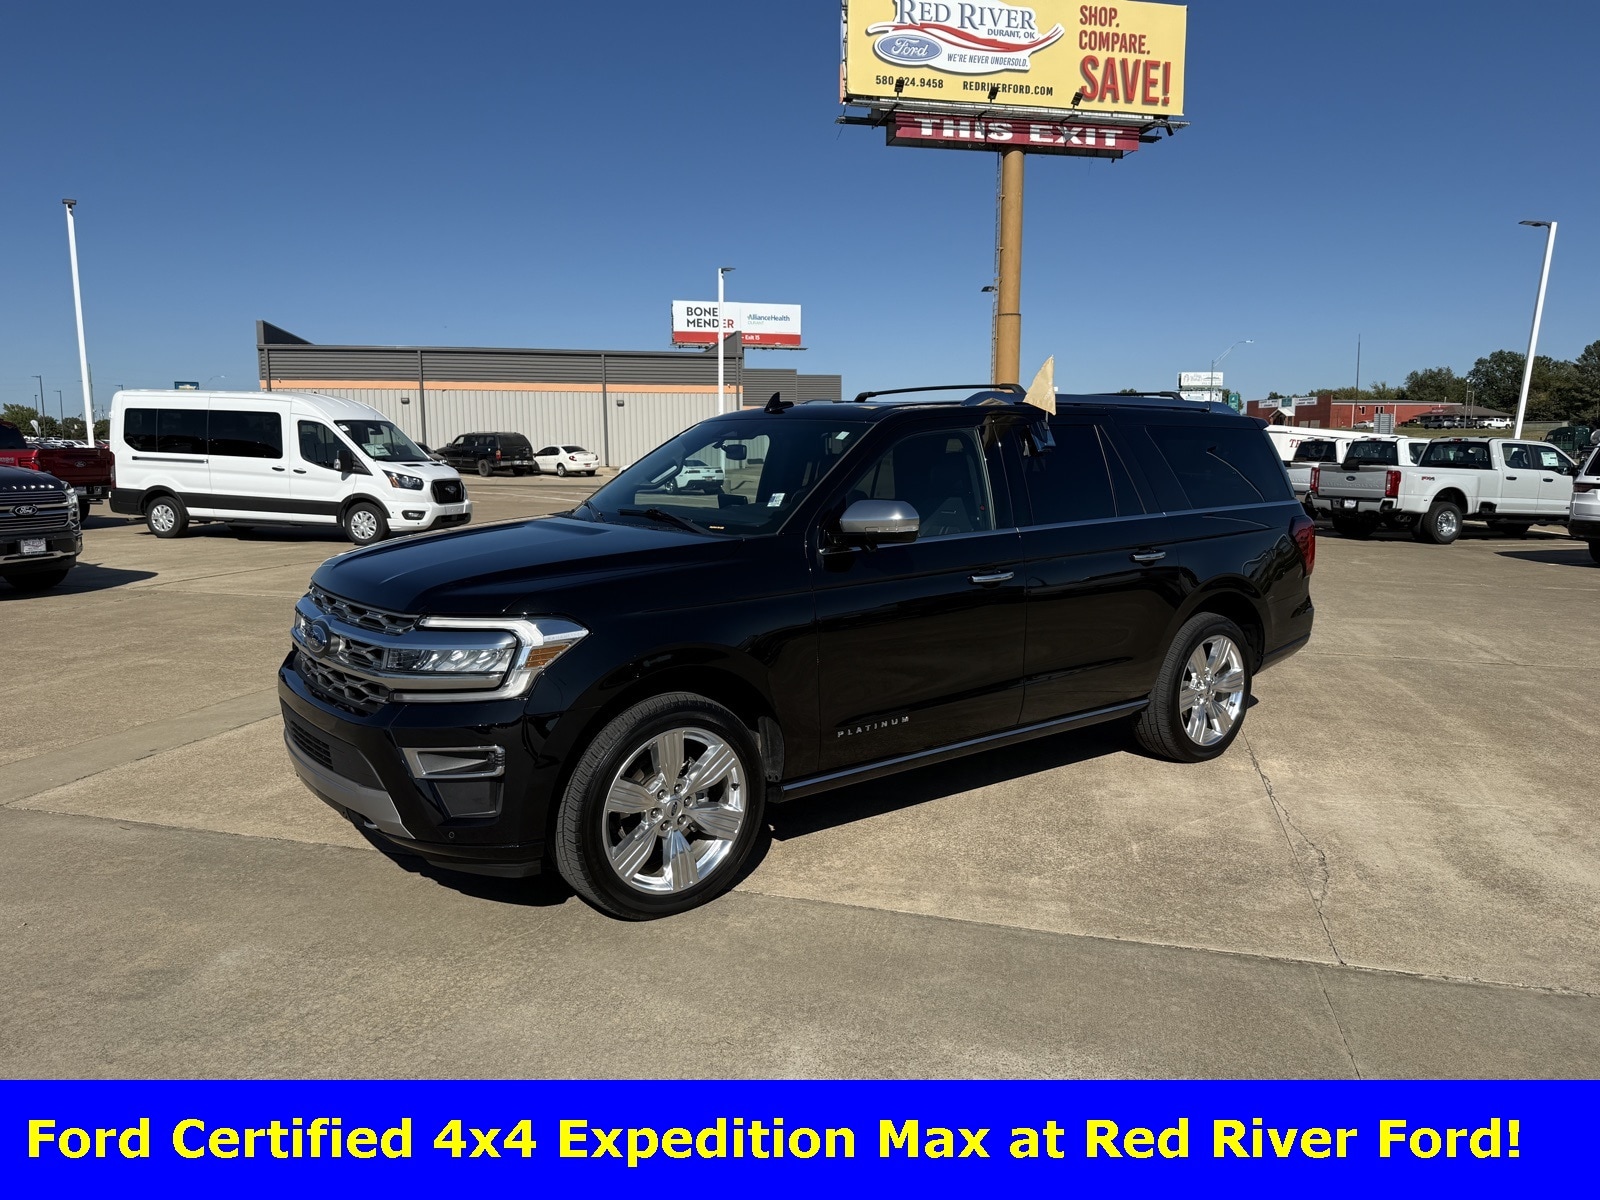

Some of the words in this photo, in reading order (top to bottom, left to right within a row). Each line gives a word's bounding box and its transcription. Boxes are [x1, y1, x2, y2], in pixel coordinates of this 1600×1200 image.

[897, 0, 951, 25] RED
[958, 3, 1035, 30] RIVER
[1080, 5, 1120, 28] SHOP.
[987, 28, 1021, 39] DURANT,
[1023, 30, 1035, 39] OK
[1079, 30, 1150, 55] COMPARE.
[892, 38, 929, 57] Ford
[947, 53, 968, 63] WE'RE
[968, 54, 989, 64] NEVER
[990, 55, 1028, 67] UNDERSOLD.
[875, 75, 944, 88] 58024.9458
[1080, 55, 1171, 106] SAVE!
[914, 117, 1014, 141] THIS
[1029, 124, 1124, 147] EXIT
[686, 307, 718, 317] BONE
[837, 716, 909, 738] PLATINUM
